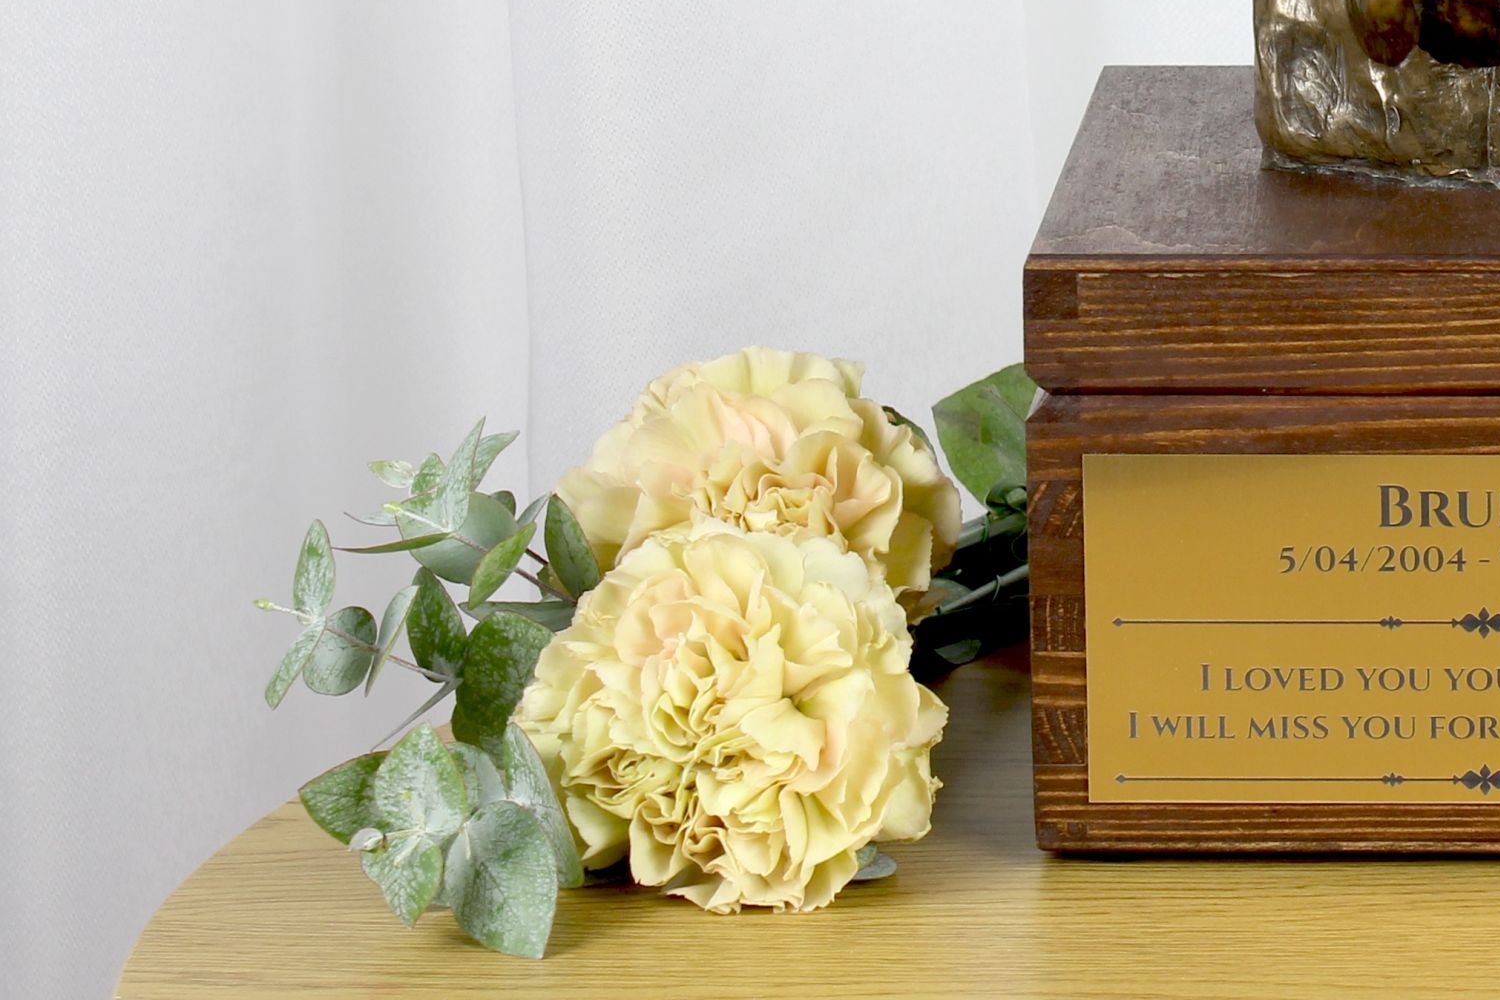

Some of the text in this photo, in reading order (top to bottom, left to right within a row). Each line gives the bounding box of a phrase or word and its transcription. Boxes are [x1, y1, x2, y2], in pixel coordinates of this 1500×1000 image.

[1278, 545, 1468, 575] 5/04/2004
[1199, 664, 1211, 692] I
[1223, 667, 1345, 692] LOVED
[1356, 667, 1432, 692] YOU
[1127, 711, 1139, 740] I
[1151, 715, 1236, 740] WILL
[1247, 715, 1330, 740] MISS
[1341, 715, 1417, 740] YOU
[1428, 715, 1500, 740] FOR
